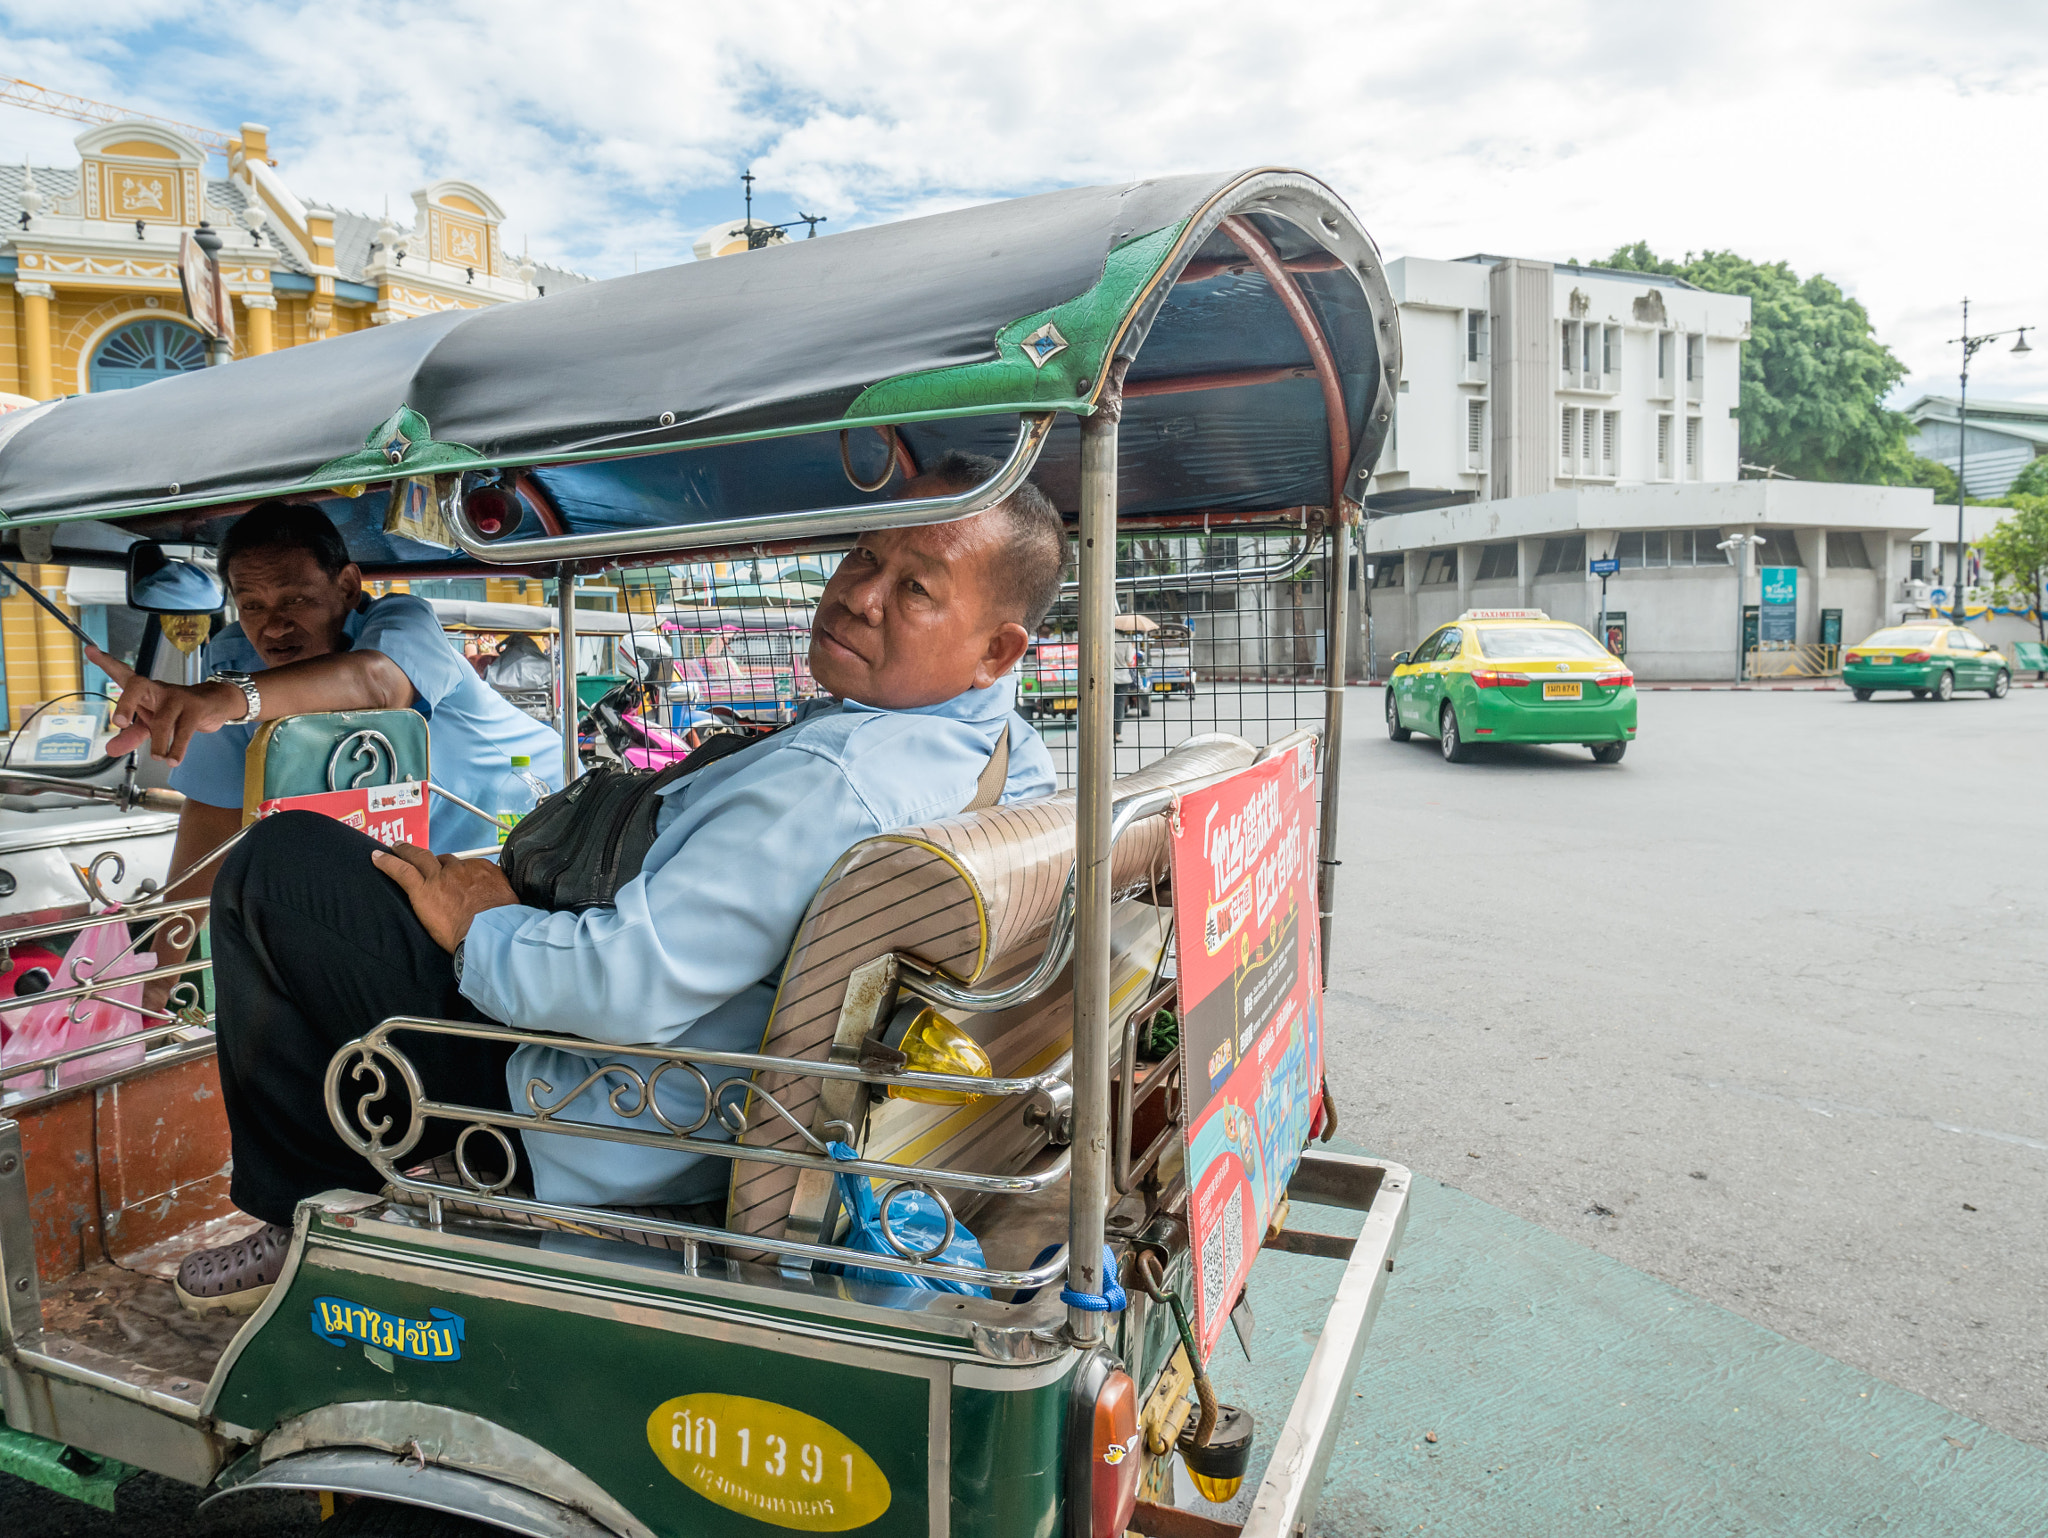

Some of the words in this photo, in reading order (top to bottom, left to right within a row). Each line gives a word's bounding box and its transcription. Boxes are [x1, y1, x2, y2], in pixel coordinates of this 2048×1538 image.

[320, 1302, 454, 1357] เมาไม่ขับ
[671, 1409, 717, 1458] สก
[737, 1428, 853, 1493] 1391
